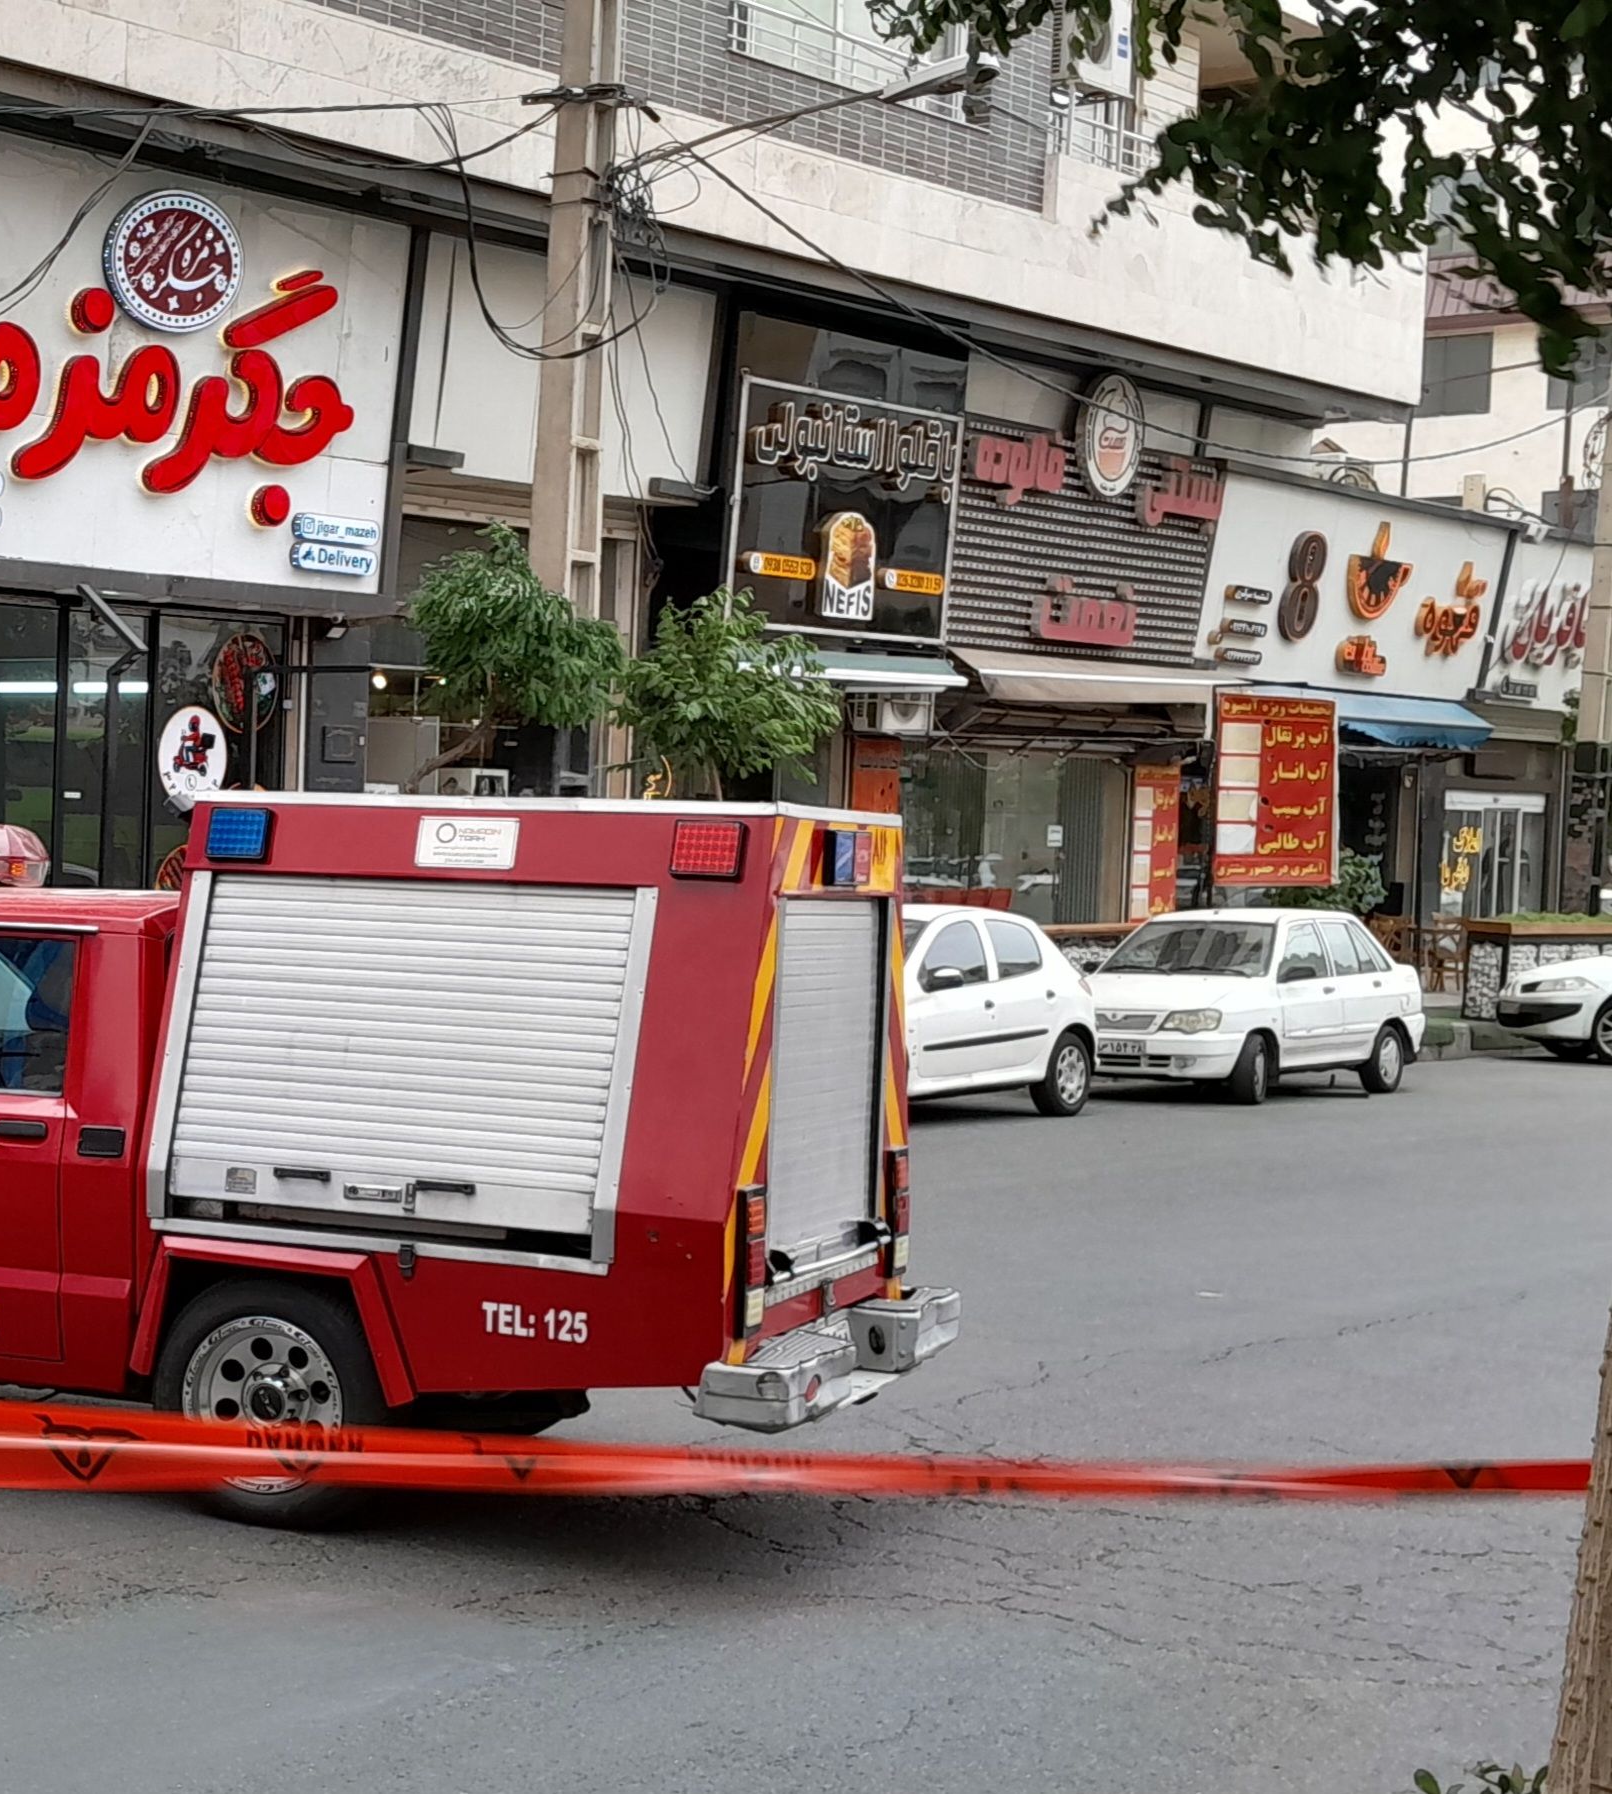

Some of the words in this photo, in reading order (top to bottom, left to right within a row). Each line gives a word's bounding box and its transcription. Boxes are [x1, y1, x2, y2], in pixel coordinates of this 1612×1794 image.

[142, 270, 355, 529] جگر
[316, 520, 377, 539] jigar_mazeh
[317, 547, 373, 573] Delivery
[823, 582, 872, 617] NEFIS
[1309, 726, 1329, 749] آب
[1307, 762, 1328, 785] آب
[1271, 805, 1301, 819] سیب
[1303, 797, 1327, 820] آب
[1257, 832, 1300, 856] طالبی
[1302, 831, 1326, 855] آب
[482, 1301, 536, 1338] TEL:
[544, 1308, 588, 1344] 125
